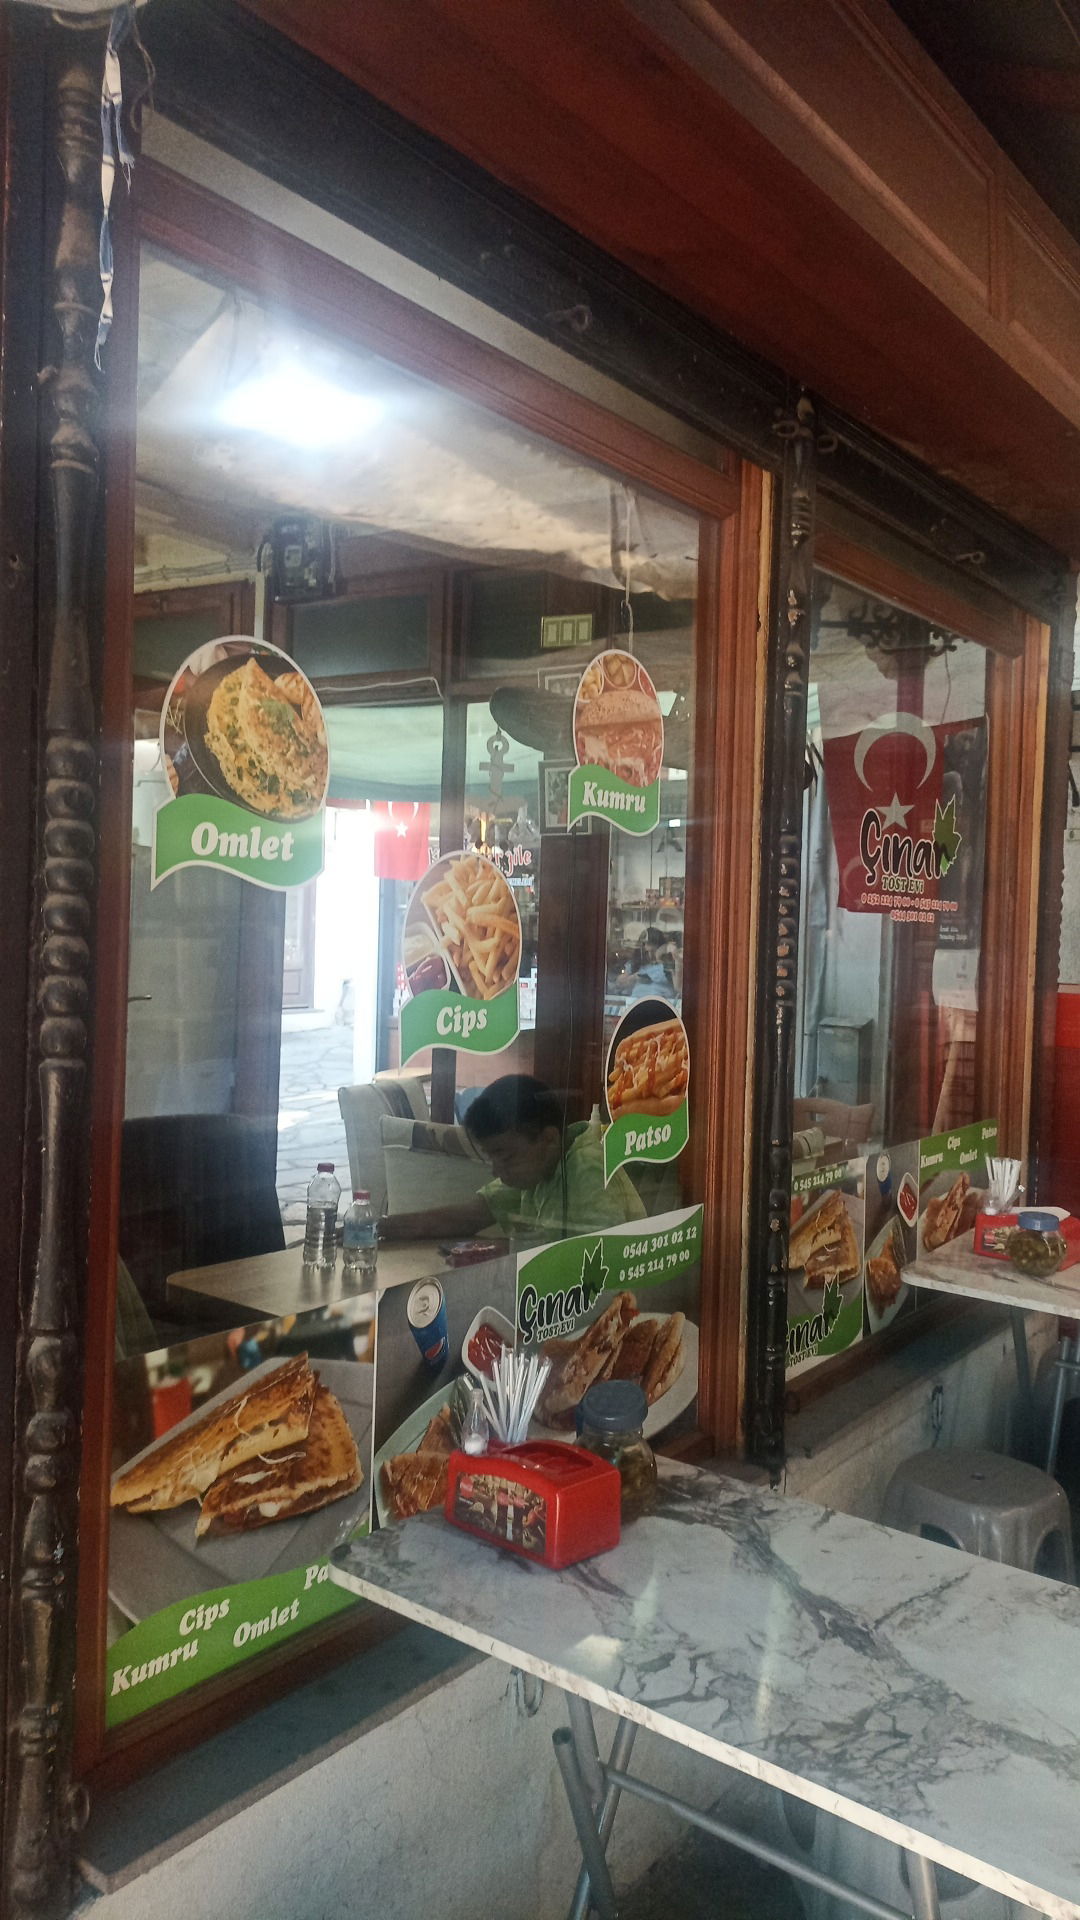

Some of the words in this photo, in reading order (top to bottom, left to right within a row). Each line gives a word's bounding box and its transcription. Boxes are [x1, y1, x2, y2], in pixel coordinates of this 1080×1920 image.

[582, 780, 646, 814] Kumru
[191, 821, 295, 862] Omlet
[882, 875, 907, 892] TOST
[436, 1005, 488, 1038] Cips
[624, 1124, 672, 1156] Patso
[793, 1181, 799, 1191] 0
[623, 1240, 648, 1259] 0544
[650, 1233, 669, 1253] 301
[671, 1230, 683, 1244] 02
[686, 1226, 697, 1240] 12
[619, 1269, 626, 1282] 0
[627, 1263, 645, 1281] 545
[647, 1256, 664, 1273] 214
[666, 1253, 677, 1269] 79
[679, 1249, 690, 1262] 00
[537, 1323, 560, 1343] TOST
[785, 1313, 836, 1357] ınar
[304, 1565, 329, 1590] Pa
[179, 1598, 231, 1637] Cips
[232, 1598, 300, 1648] Omlet
[110, 1638, 199, 1697] Kumru
